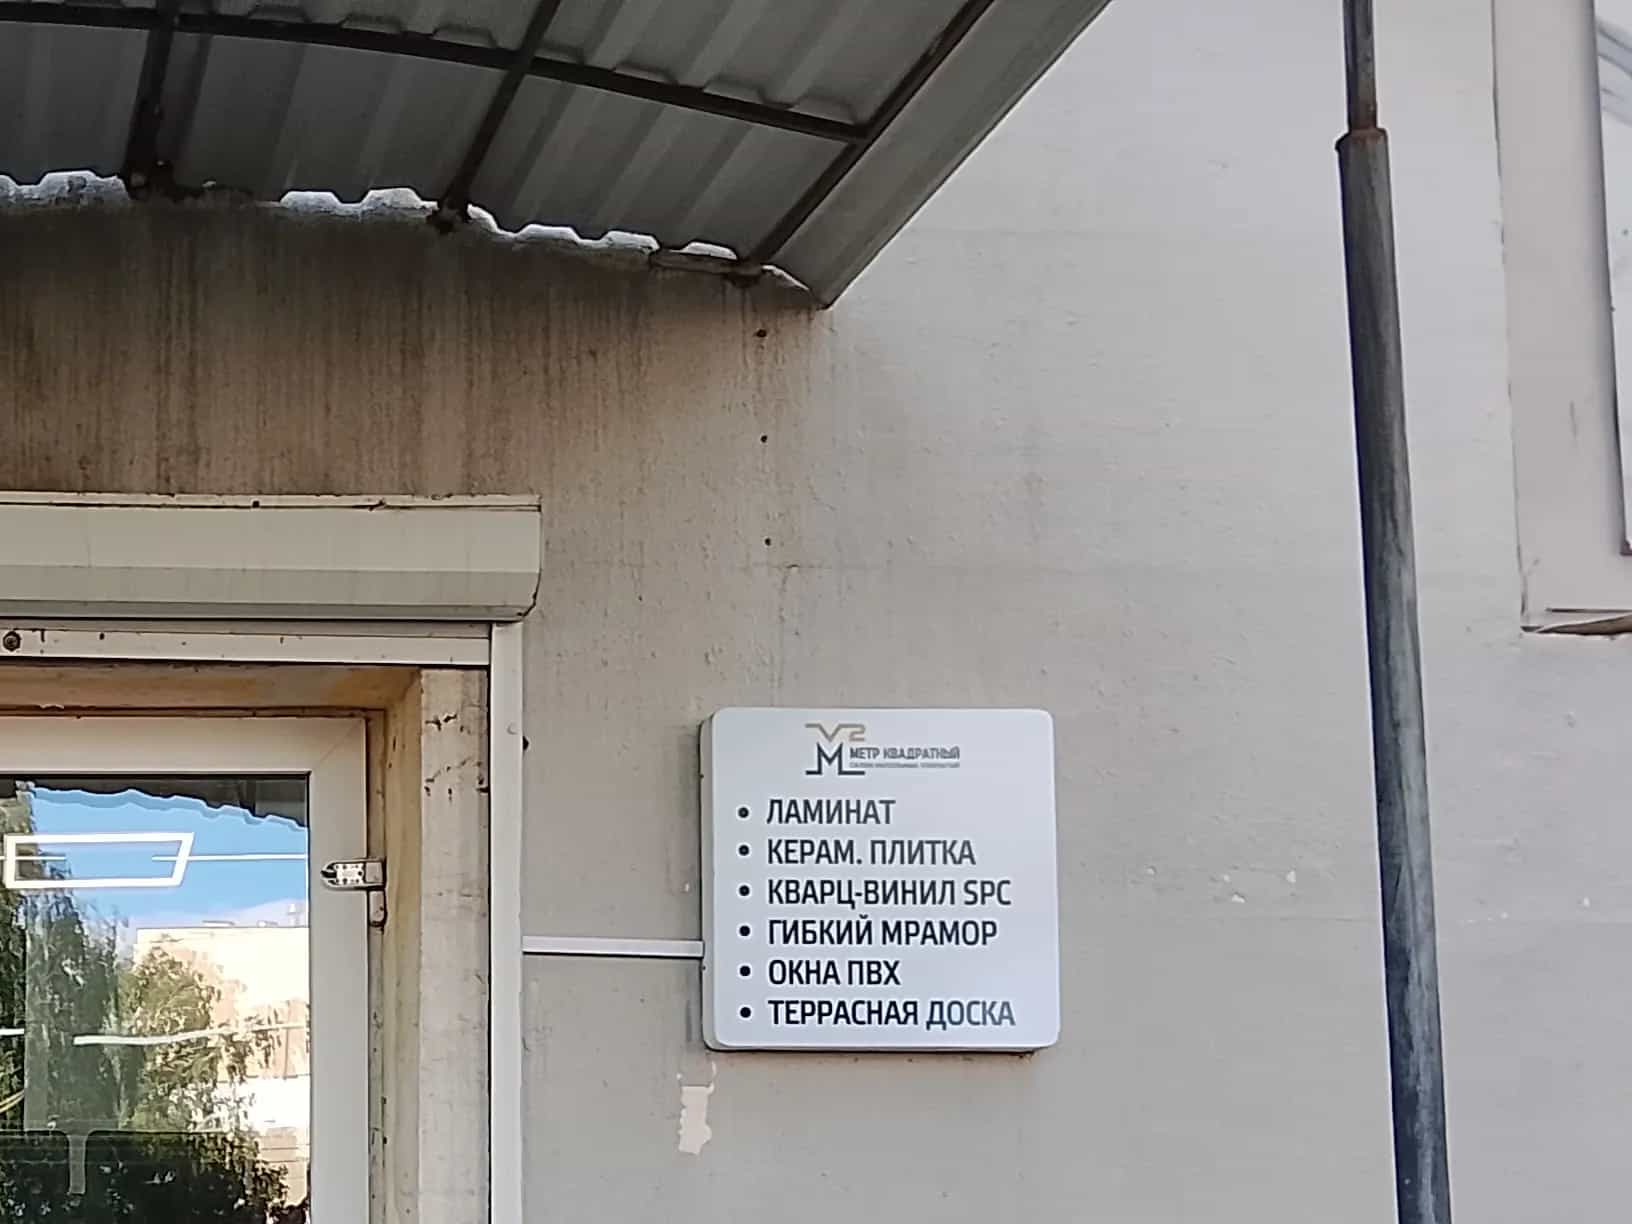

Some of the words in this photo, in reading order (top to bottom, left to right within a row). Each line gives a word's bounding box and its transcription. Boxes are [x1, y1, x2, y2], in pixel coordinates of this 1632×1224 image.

[767, 799, 896, 824] ЛАМИНАТ
[768, 839, 862, 864] КЕРАМ.
[871, 840, 976, 865] ПЛИТКА
[769, 880, 954, 909] КВАРЦ-ВИНИЛ
[964, 880, 1011, 905] SPC
[770, 914, 872, 944] ГИБКИЙ
[882, 921, 996, 945] МРАМОР
[769, 960, 840, 985] ОКНА
[848, 960, 900, 985] ПВХ
[768, 1000, 918, 1025] ТЕРРАСНАЯ
[926, 1001, 1015, 1030] ДОСКА
